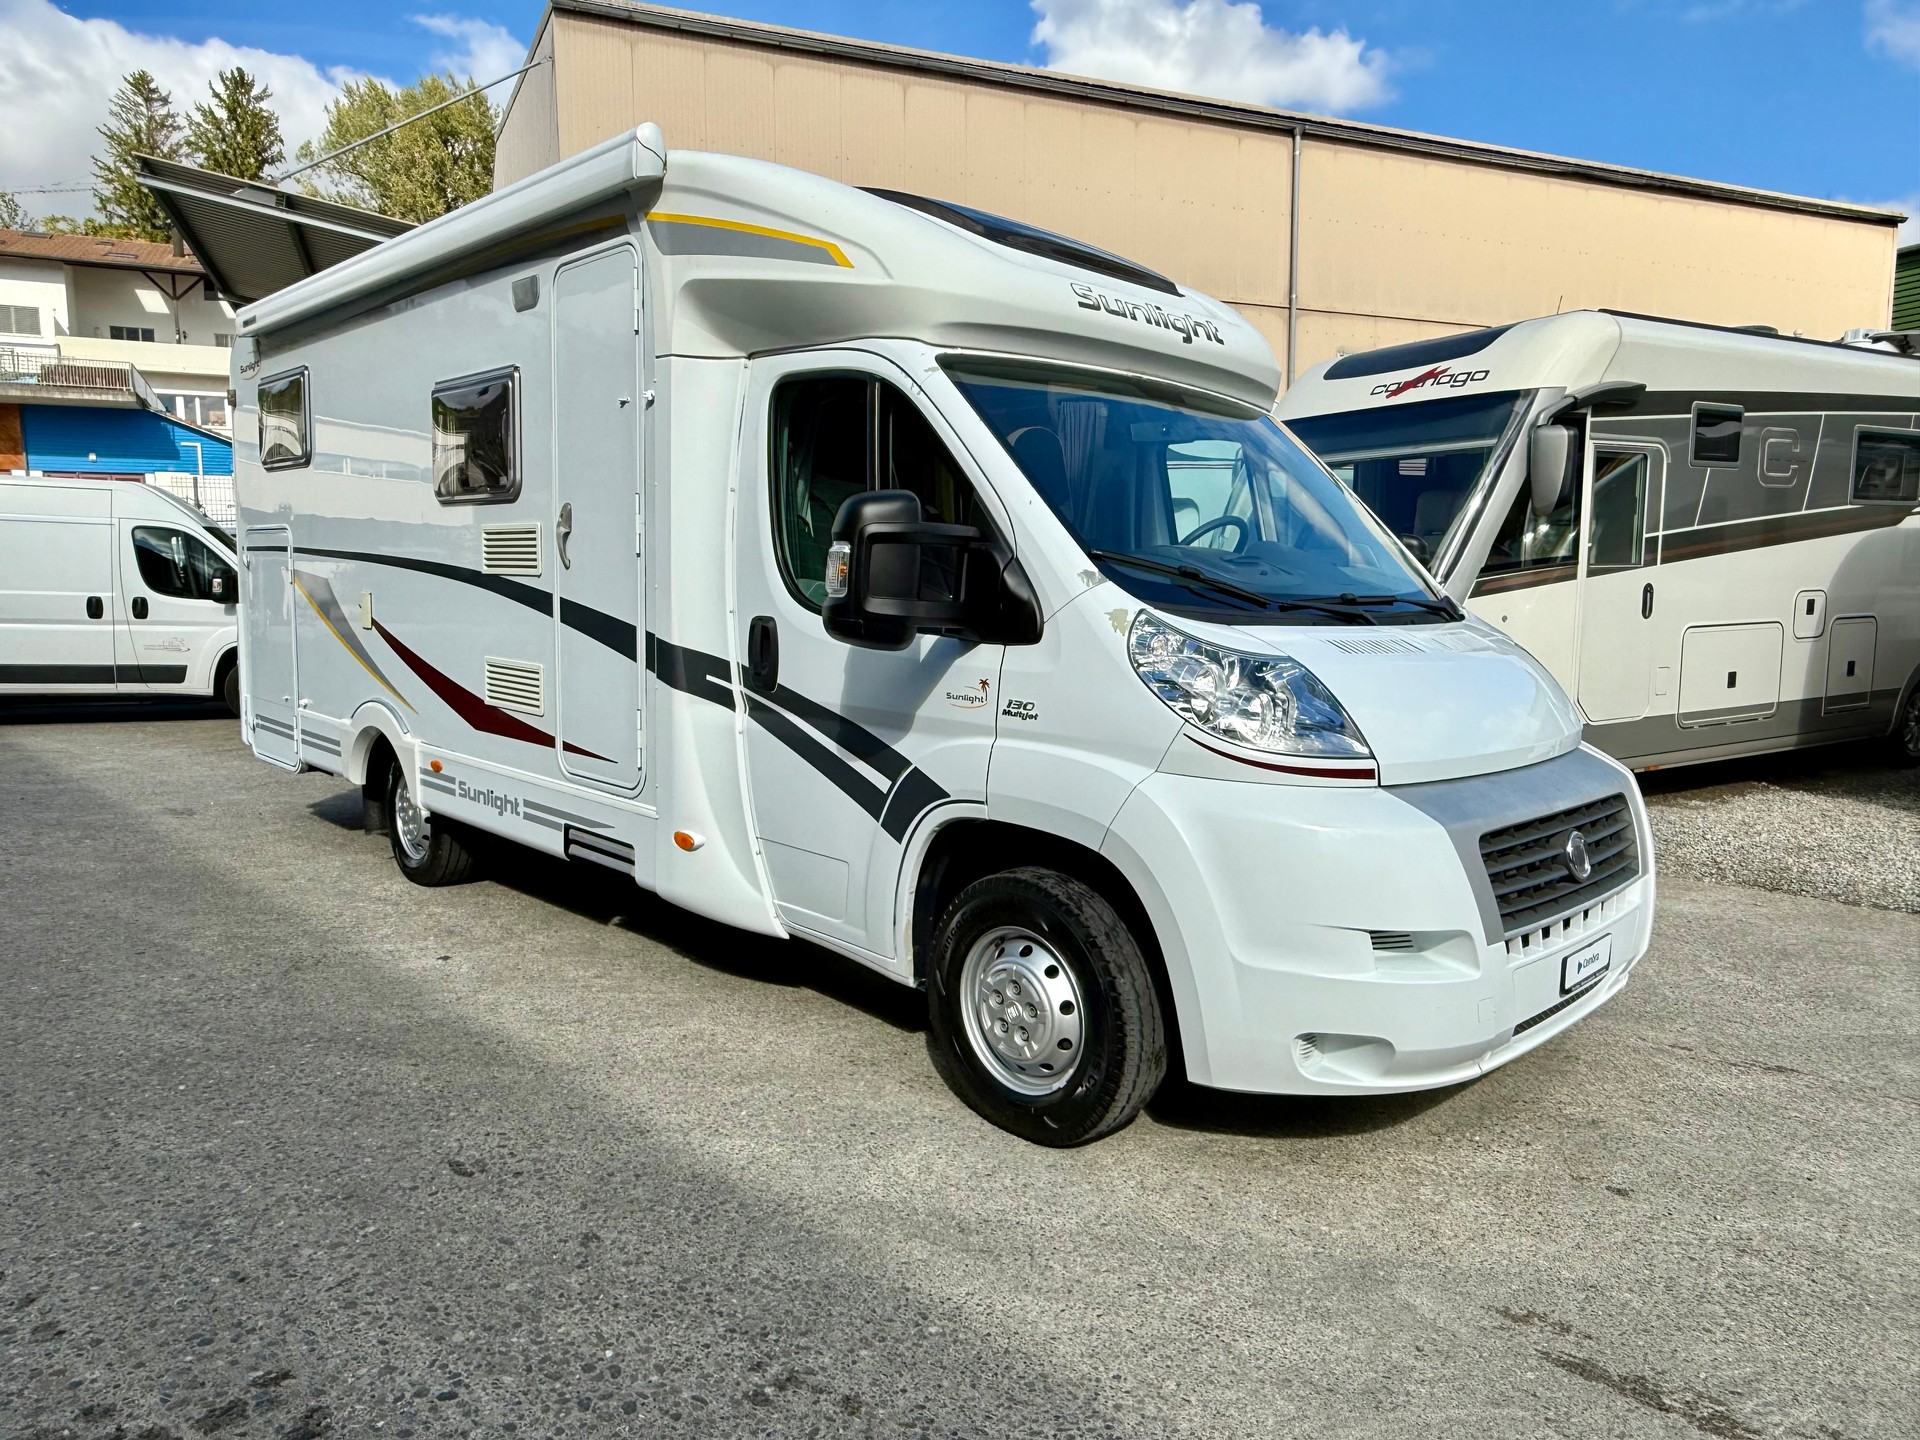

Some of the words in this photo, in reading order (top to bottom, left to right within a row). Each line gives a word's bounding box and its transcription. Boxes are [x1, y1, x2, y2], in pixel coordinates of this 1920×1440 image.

[1070, 282, 1225, 346] Sunlight
[945, 692, 984, 705] Sunlight
[1006, 698, 1036, 712] 130
[1001, 708, 1040, 721] Multijet
[458, 780, 521, 817] Sunlight
